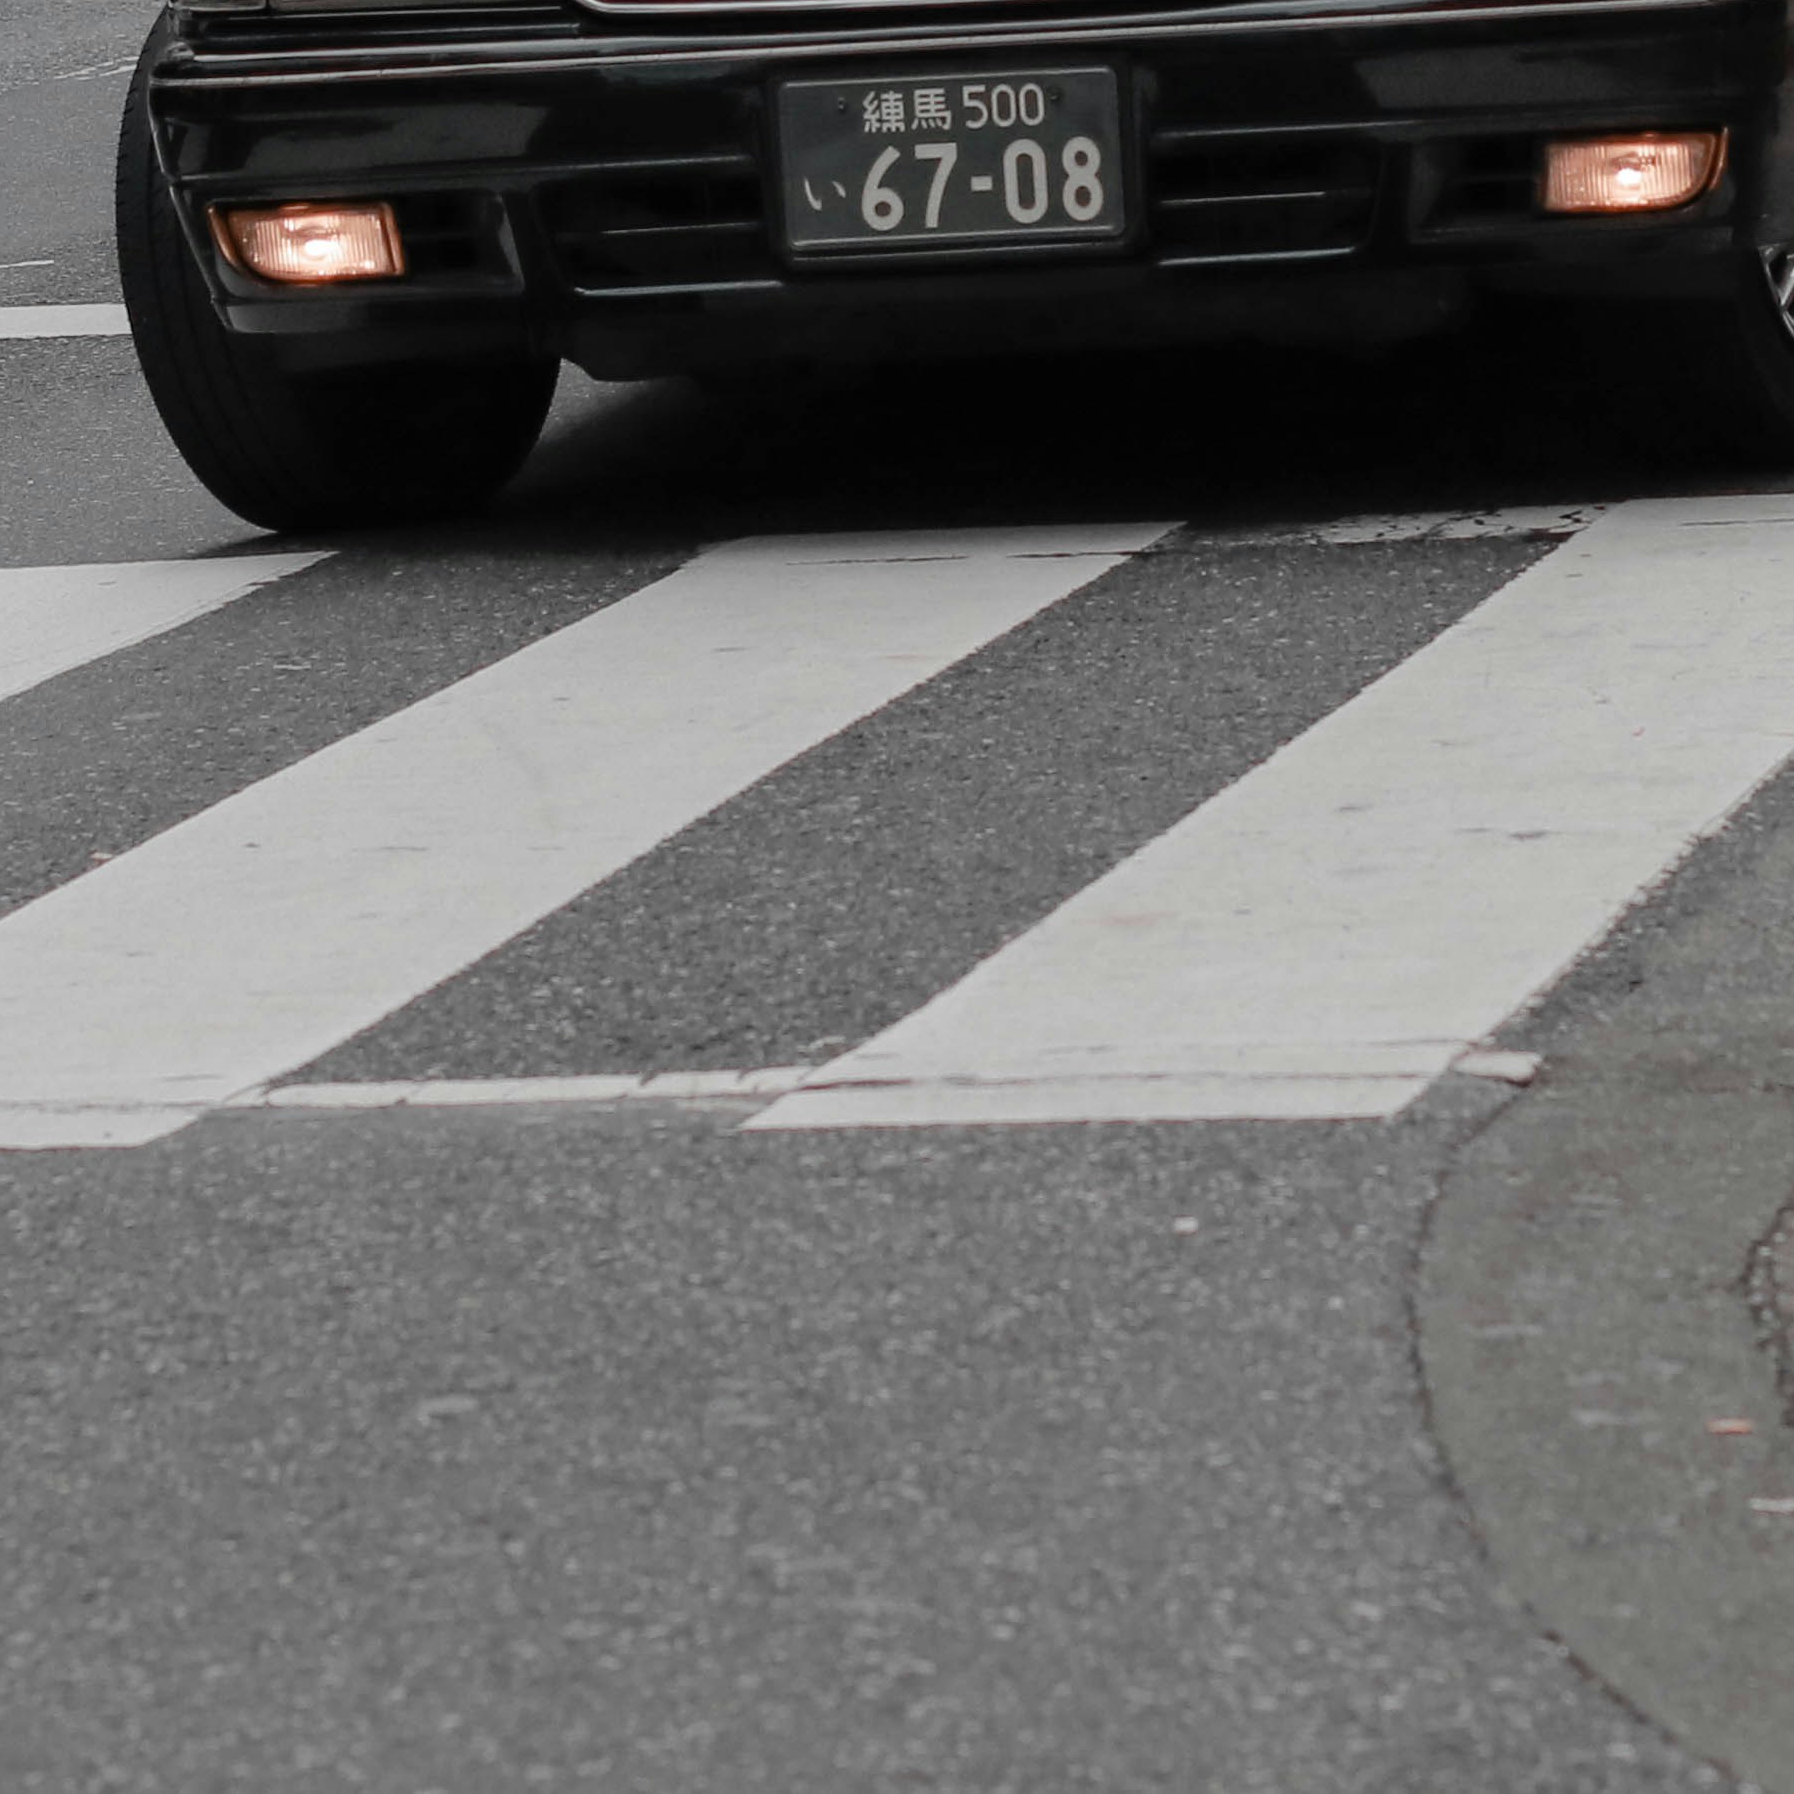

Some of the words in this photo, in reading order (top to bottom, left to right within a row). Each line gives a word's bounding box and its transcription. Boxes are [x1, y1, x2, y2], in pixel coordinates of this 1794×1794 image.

[862, 86, 954, 134] 練馬
[962, 82, 1046, 130] 500
[804, 175, 848, 212] い
[861, 135, 1105, 232] 67-08
